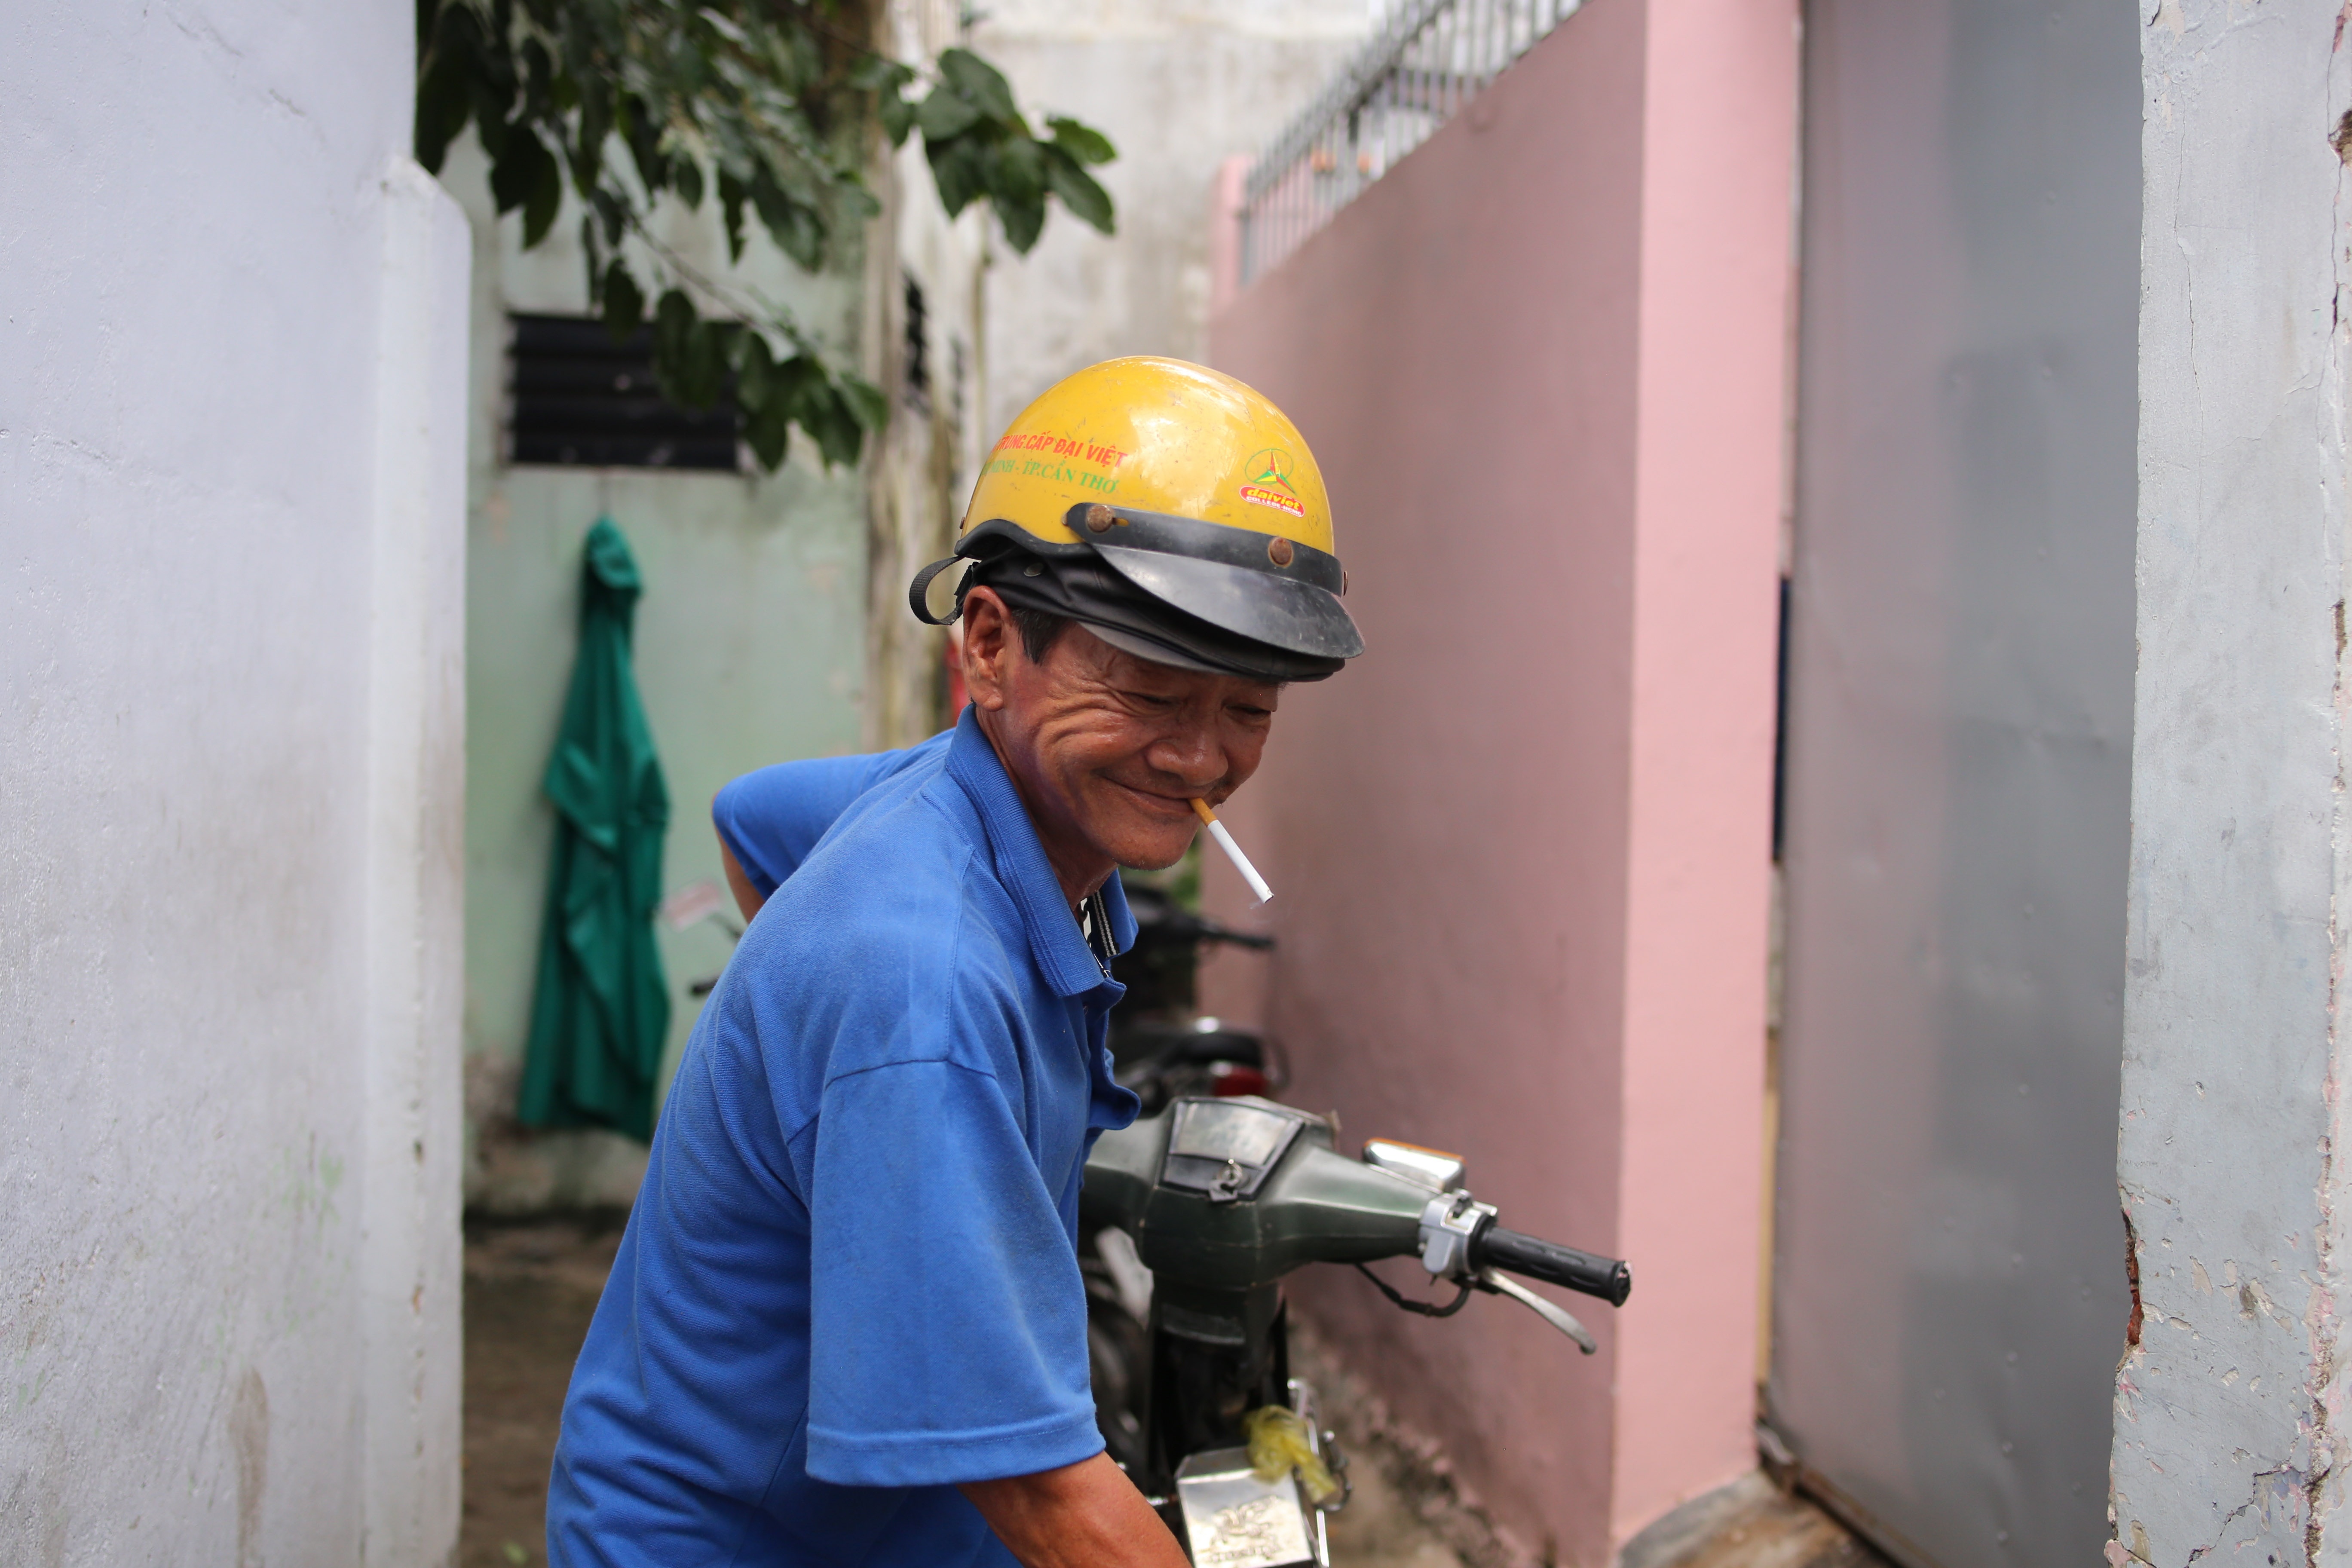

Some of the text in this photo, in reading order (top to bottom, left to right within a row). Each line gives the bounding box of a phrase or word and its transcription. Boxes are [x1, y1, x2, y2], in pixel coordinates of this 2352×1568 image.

[1026, 431, 1054, 451] CẤP
[1053, 438, 1084, 459] ĐẠI
[1086, 445, 1128, 468] VIỆT
[1079, 472, 1120, 494] THƠ
[1247, 488, 1300, 510] daiviet
